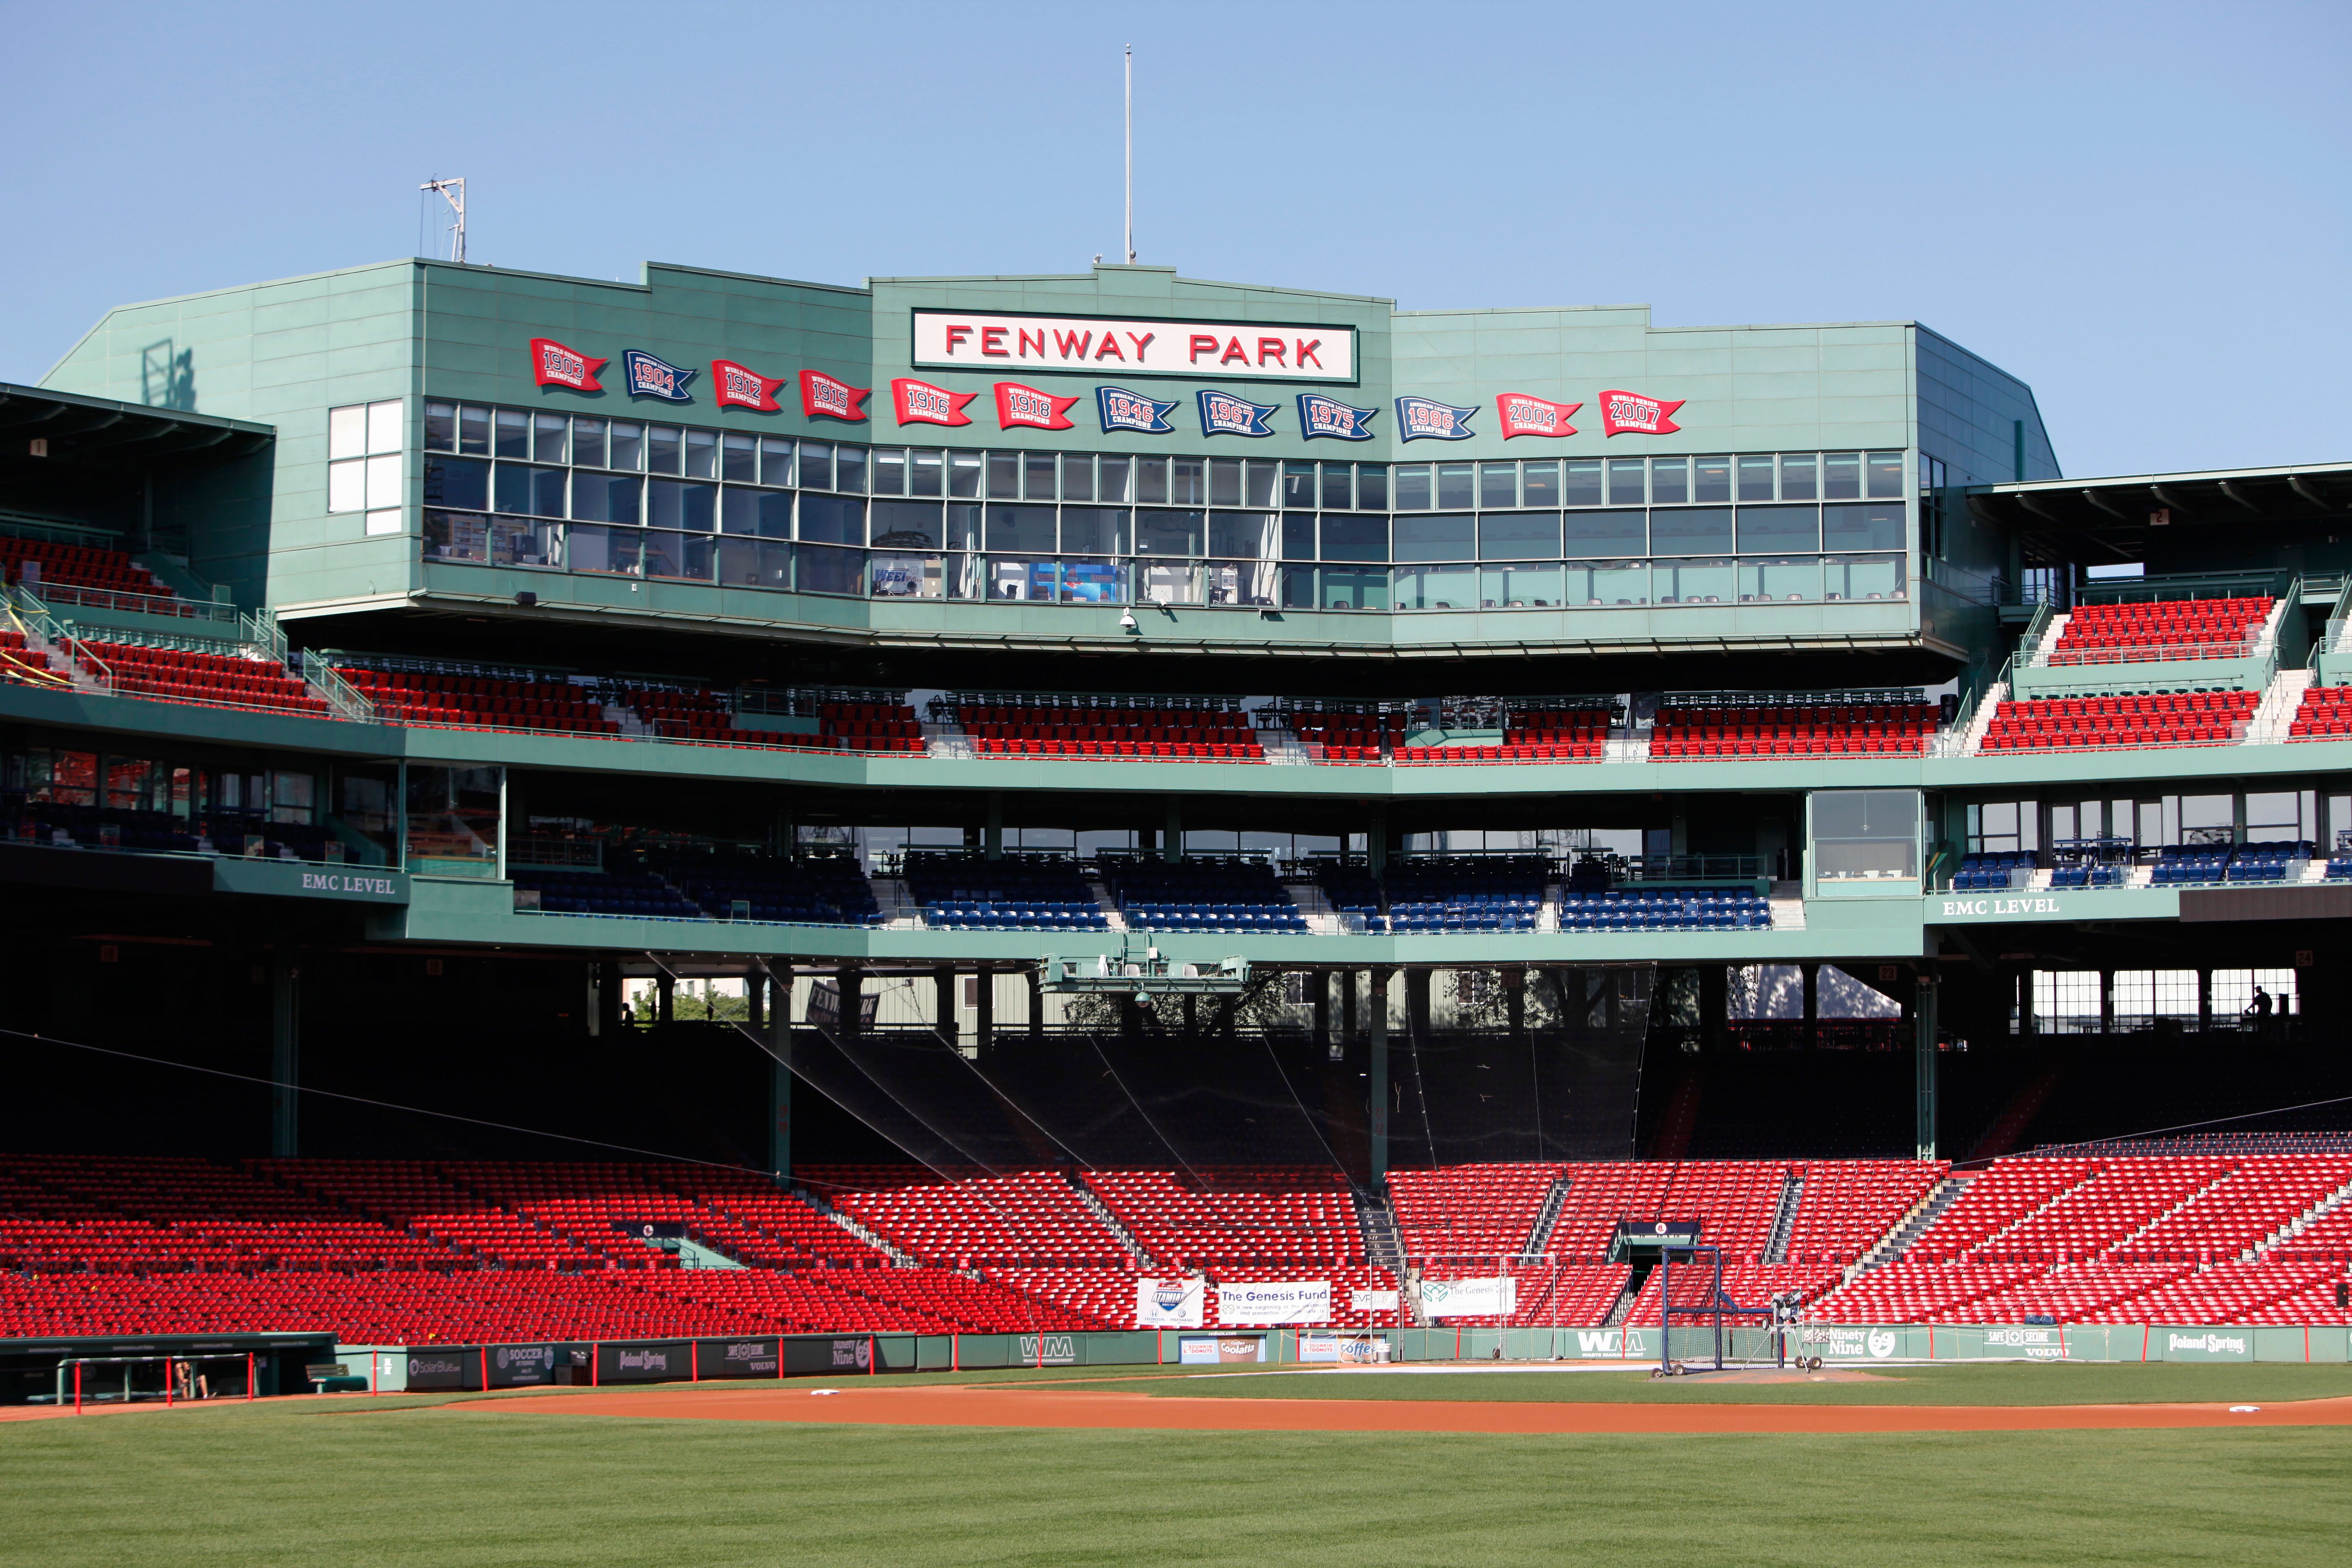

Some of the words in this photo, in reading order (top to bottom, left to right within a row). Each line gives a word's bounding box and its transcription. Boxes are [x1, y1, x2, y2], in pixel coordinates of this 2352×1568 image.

[946, 325, 1153, 361] FENWAY
[1189, 334, 1321, 366] PARK
[544, 345, 563, 354] WORLD
[564, 351, 583, 363] SERIES
[544, 352, 584, 379] 1903
[636, 357, 657, 366] AMERICAN
[658, 364, 673, 374] LEAGUE
[547, 371, 582, 386] CHAMPIONS
[634, 363, 674, 390] 1904
[725, 366, 743, 376] WORLD
[744, 372, 761, 384] SERIES
[638, 382, 672, 396] CHAMPIONS
[726, 373, 761, 400] 1912
[812, 376, 830, 385] WORLD
[831, 382, 848, 393] SERIES
[906, 384, 928, 392] WORLD
[929, 389, 949, 399] SERIES
[727, 392, 760, 406] CHAMPIONS
[813, 382, 848, 409] 1915
[1031, 392, 1051, 402] SERIES
[1135, 398, 1153, 406] LEAGUE
[1635, 398, 1658, 407] SERIES
[814, 401, 846, 415] CHAMPIONS
[908, 391, 949, 415] 1916
[1010, 395, 1050, 418] 1918
[1109, 398, 1154, 422] 1946
[1235, 402, 1253, 410] LEAGUE
[1336, 405, 1352, 414] LEAGUE
[1534, 402, 1555, 411] SERIES
[909, 408, 948, 421] CHAMPIONS
[1011, 412, 1050, 425] CHAMPIONS
[1210, 402, 1254, 426] 1967
[1310, 405, 1354, 429] 1975
[1408, 407, 1454, 429] 1986
[1509, 405, 1556, 427] 2004
[1609, 401, 1660, 424] 2007
[1113, 416, 1151, 428] CHAMPIONS
[1214, 420, 1251, 433] CHAMPIONS
[1514, 422, 1553, 433] CHAMPIONS
[1616, 420, 1656, 431] CHAMPIONS
[1314, 423, 1351, 436] CHAMPIONS
[1412, 425, 1450, 436] CHAMPIONS
[2156, 511, 2162, 522] 2
[875, 569, 907, 582] WEEI
[302, 873, 338, 891] EMC
[343, 877, 395, 894] LEVEL
[1943, 900, 1987, 916] EMC
[1994, 898, 2059, 914] LEVEL
[2298, 953, 2310, 964] 24
[1882, 967, 1893, 979] 23
[809, 986, 840, 1013] FENW
[1151, 1292, 1187, 1303] ATAMIAN
[1222, 1291, 1242, 1301] The
[1246, 1291, 1295, 1301] Genesis
[1299, 1289, 1327, 1300] Fund
[1450, 1287, 1463, 1295] The
[1465, 1286, 1494, 1295] Genesis
[1577, 1331, 1644, 1351] WM
[1829, 1328, 1866, 1342] Ninety
[1988, 1331, 2004, 1342] SAFE
[2025, 1331, 2049, 1342] SECURE
[1020, 1336, 1074, 1357] WM
[1221, 1342, 1255, 1354] Coolatta
[1828, 1340, 1864, 1355] Nine
[2169, 1333, 2206, 1351] Poland
[2208, 1333, 2244, 1354] Spring
[509, 1348, 543, 1361] SOCCER
[833, 1350, 854, 1365] Nine
[2024, 1348, 2070, 1357] VOLVO
[620, 1350, 644, 1370] Poland
[643, 1350, 667, 1371] Spring
[750, 1361, 776, 1370] VOLVO
